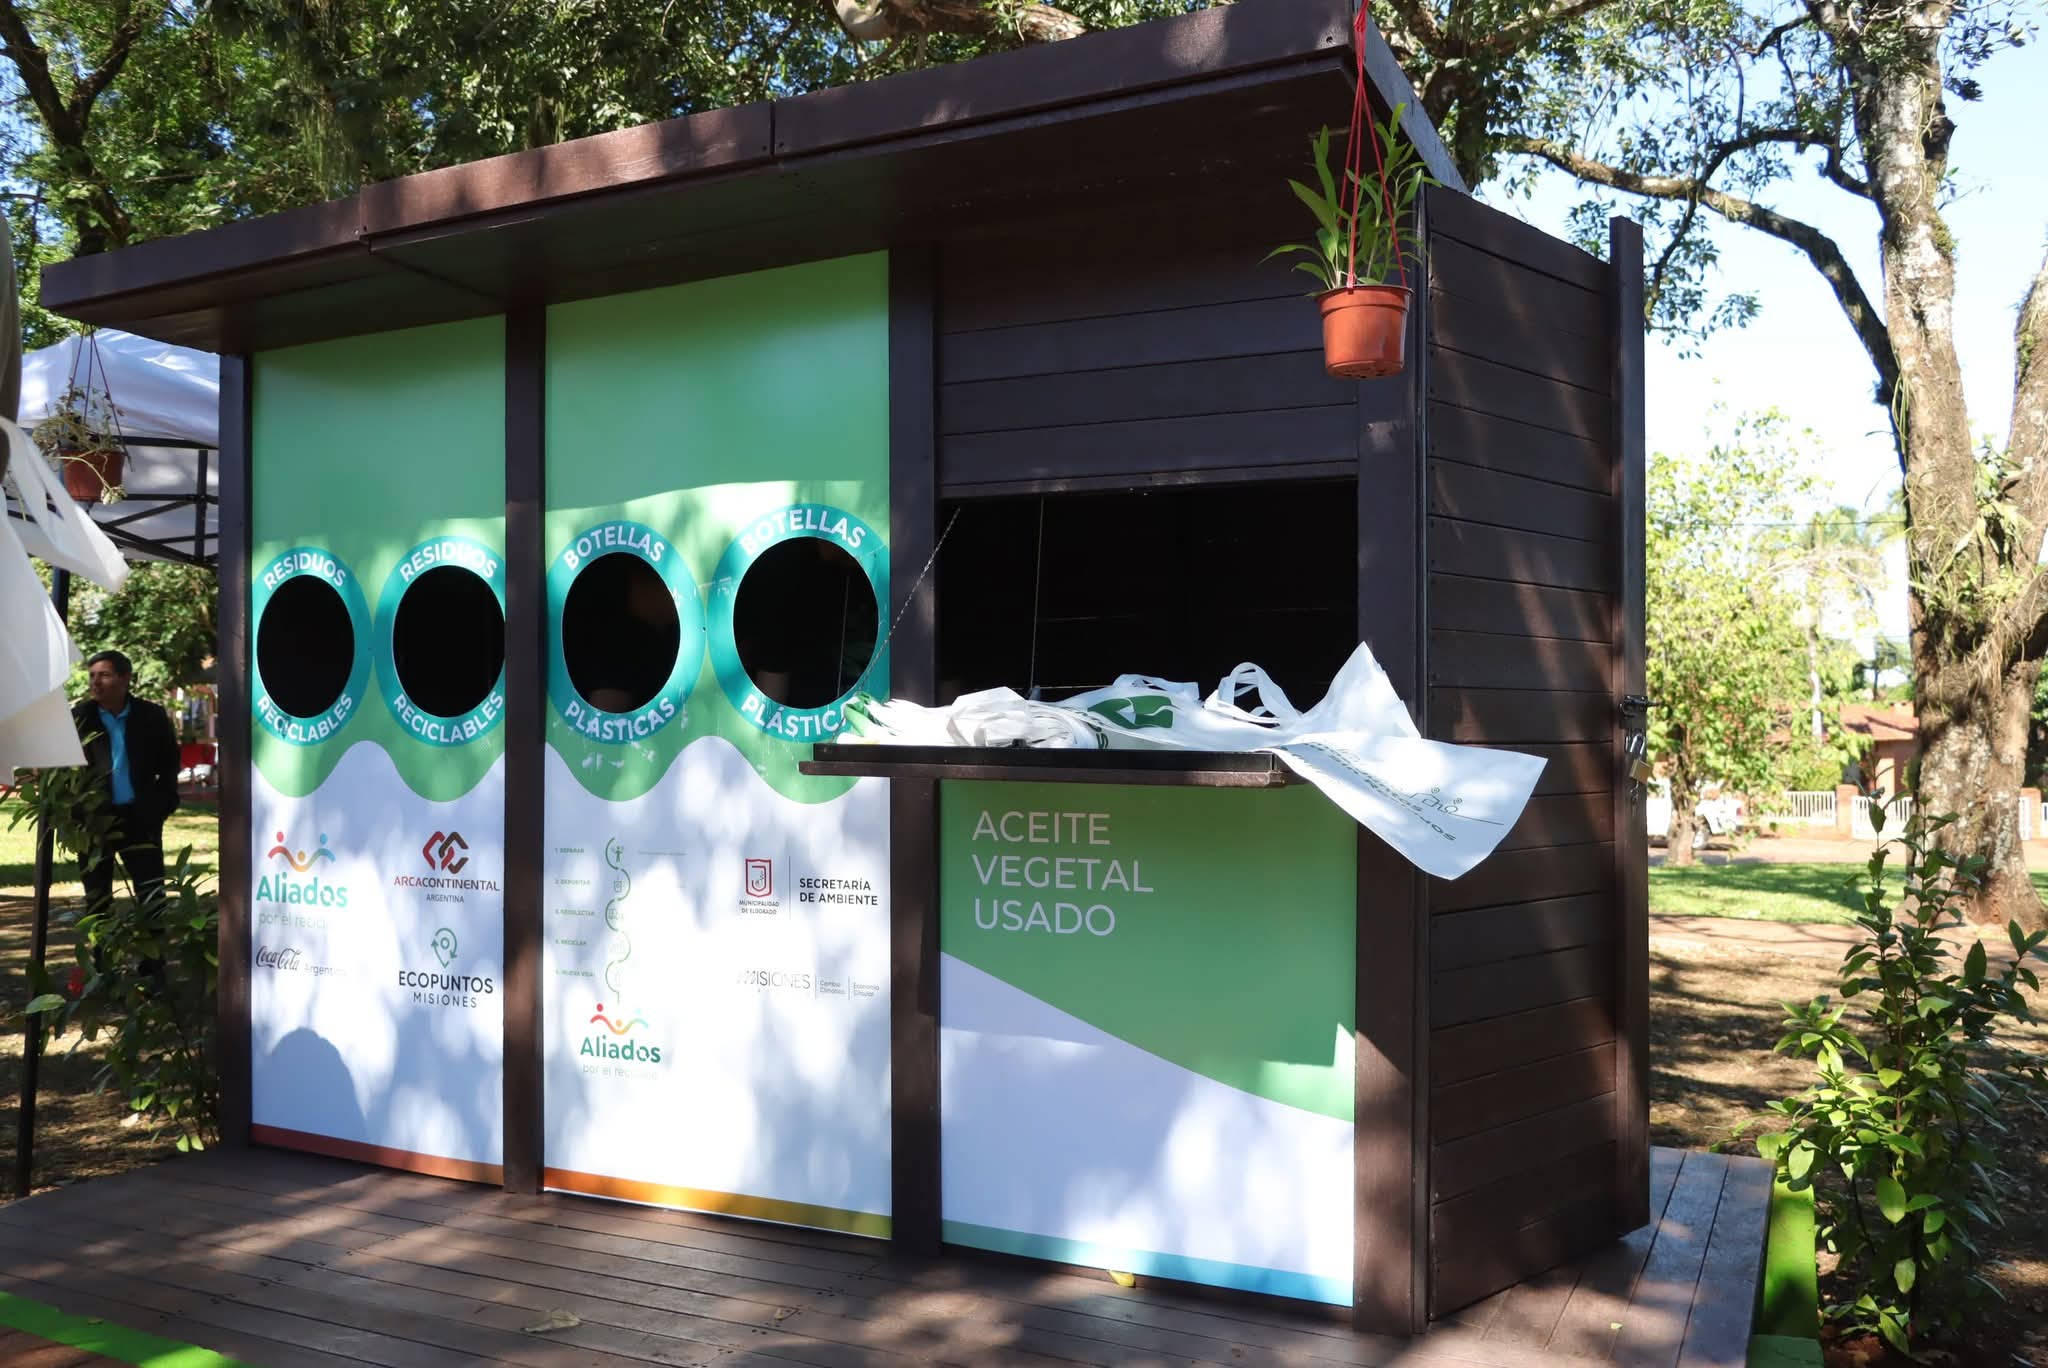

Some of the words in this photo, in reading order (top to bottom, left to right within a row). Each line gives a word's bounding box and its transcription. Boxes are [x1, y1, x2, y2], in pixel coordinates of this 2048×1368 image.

[563, 524, 665, 570] BOTELLAS
[740, 508, 866, 557] BOTELLAS
[263, 552, 347, 590] RESIDUOS
[400, 541, 497, 582] RESIDUOS
[257, 693, 352, 743] RECICLABLES
[394, 691, 504, 743] RECICLABLES
[564, 697, 676, 742] PLÁSTICAS
[741, 696, 847, 738] PLÁSTIC
[972, 810, 1111, 845] ACEITE
[256, 872, 349, 908] Aliados
[394, 876, 500, 892] ARCACONTINENTAL
[799, 877, 871, 891] SECRETARÍA
[972, 854, 1154, 893] VEGETAL
[426, 893, 465, 903] ARGENTINA
[739, 899, 780, 907] MUNICIPALIDAD
[799, 892, 815, 903] DE
[818, 893, 878, 906] AMBIENTE
[975, 898, 1116, 936] USADO
[398, 970, 494, 994] ECOPUNTOS
[413, 992, 478, 1009] MISIONES
[580, 1034, 661, 1063] Aliados
